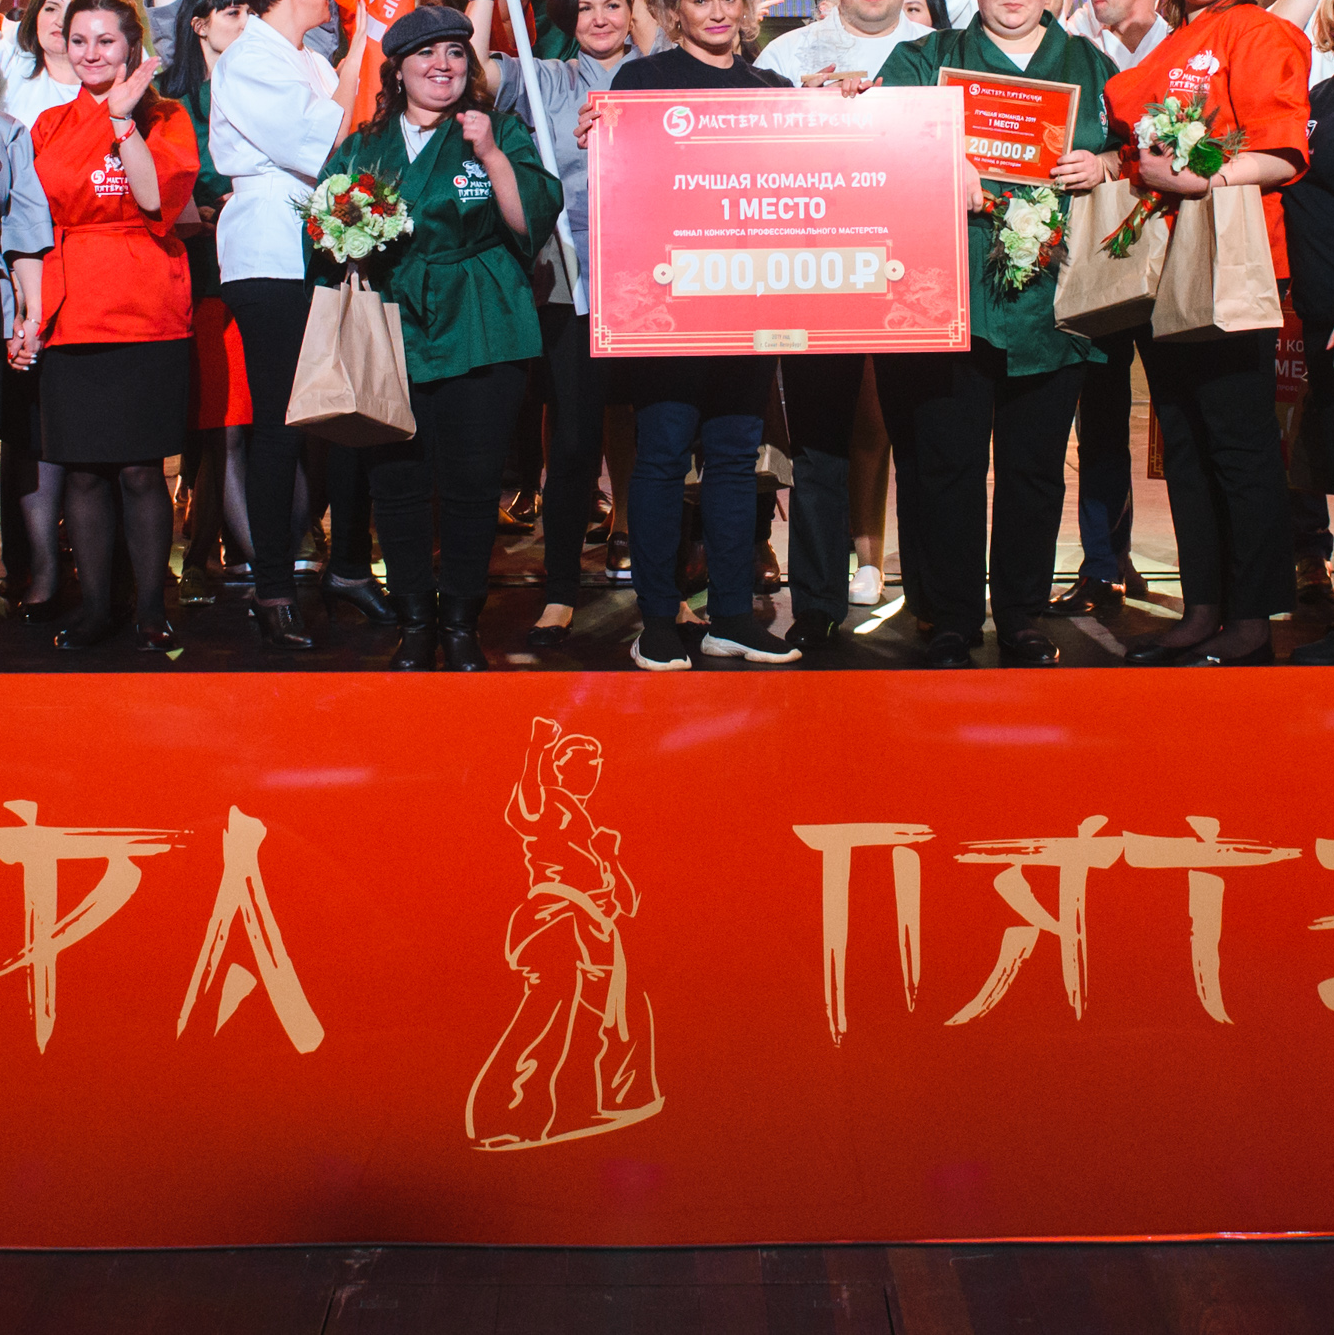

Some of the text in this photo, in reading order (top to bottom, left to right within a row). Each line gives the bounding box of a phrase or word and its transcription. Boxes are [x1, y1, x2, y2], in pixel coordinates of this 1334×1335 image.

[698, 114, 767, 129] МАСТЕРА
[993, 119, 1020, 130] МЕСТО
[673, 172, 887, 190] ЛУЧШАЯ КОМАНДА 2019
[721, 197, 826, 220] 1 МЕСТО
[673, 226, 889, 237] ФИНАЛ КОНКУРСА ПРОФЕССИОНАЛЬНОГО МАСТЕРСТВА
